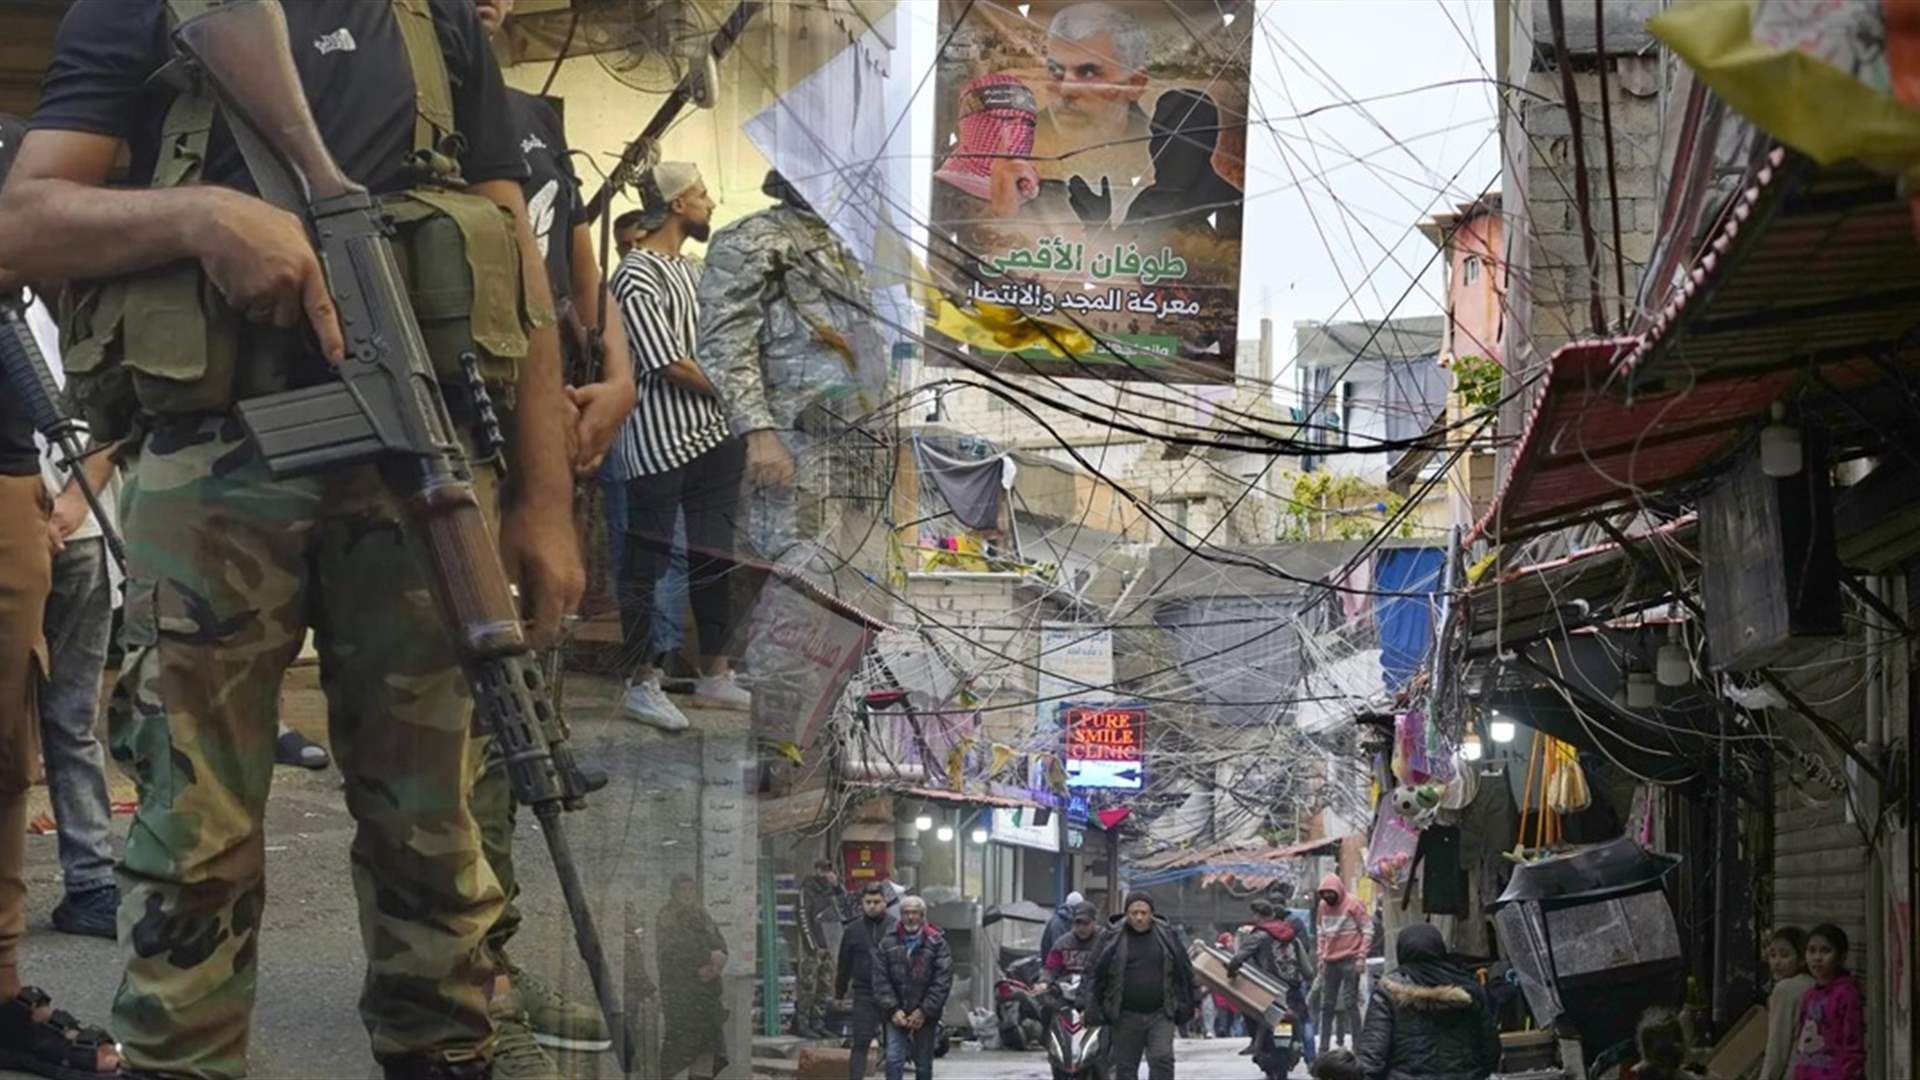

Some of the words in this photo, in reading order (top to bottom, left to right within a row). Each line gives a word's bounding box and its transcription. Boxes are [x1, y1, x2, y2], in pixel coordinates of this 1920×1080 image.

[978, 237, 1083, 277] الأقصى
[1091, 244, 1187, 285] طوفان
[1061, 288, 1121, 314] المجد
[1128, 289, 1200, 319] معركة
[1081, 711, 1131, 728] PURE
[1075, 728, 1134, 744] SMILE
[1072, 743, 1137, 760] CLINIC
